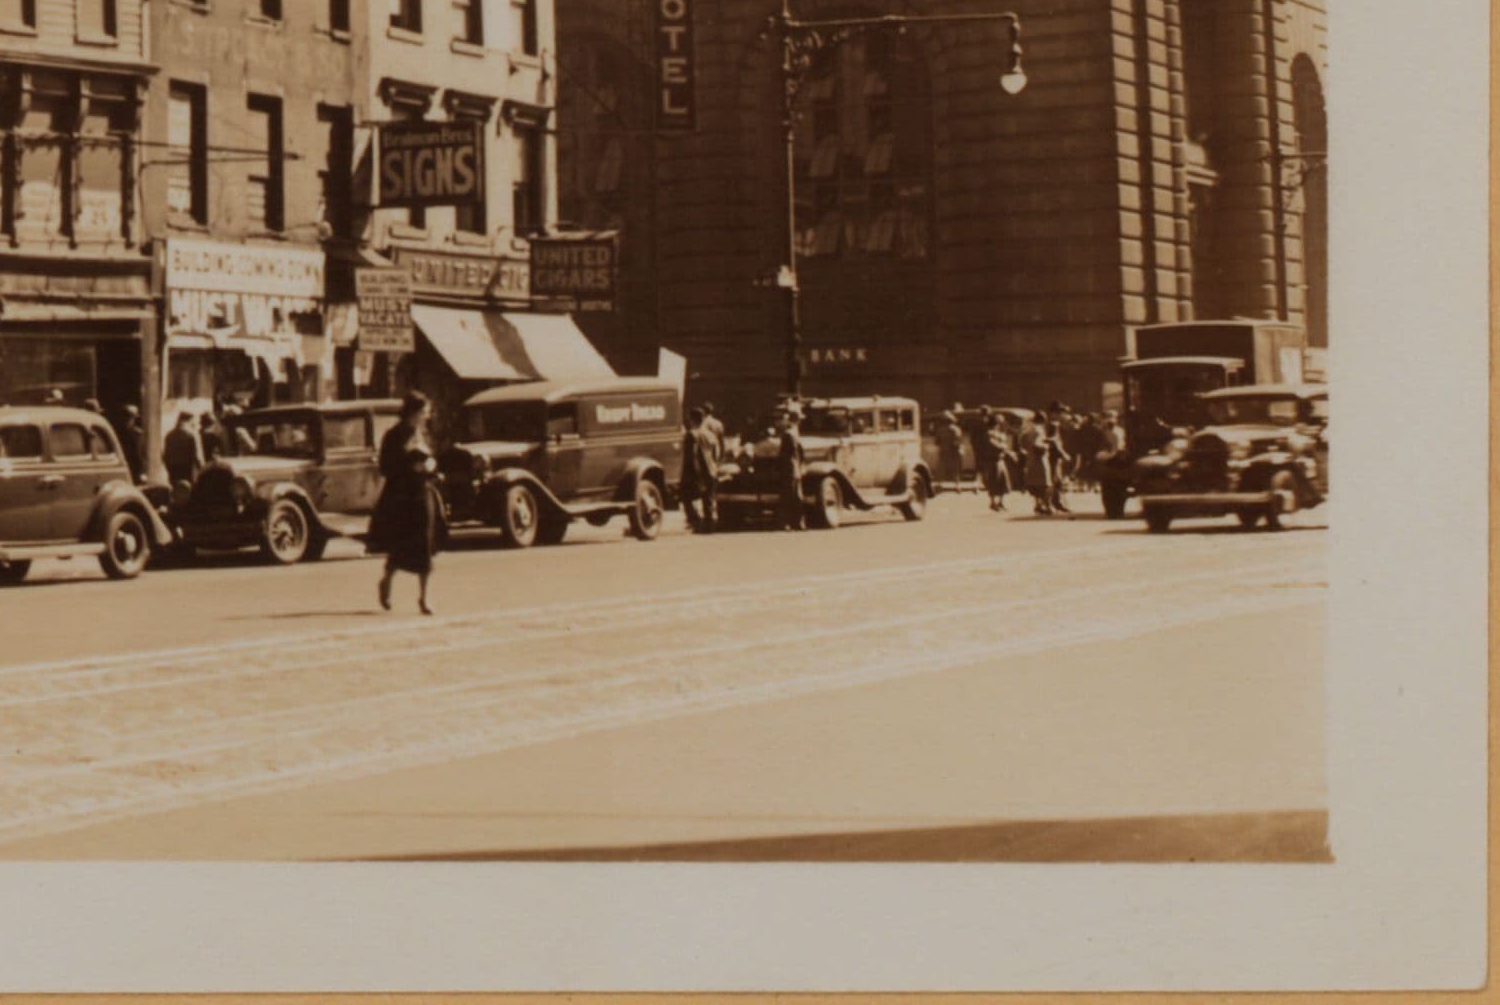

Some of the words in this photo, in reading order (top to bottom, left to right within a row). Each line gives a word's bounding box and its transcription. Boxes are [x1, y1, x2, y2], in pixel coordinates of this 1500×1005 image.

[383, 145, 475, 199] SIGNS
[174, 249, 233, 276] BUILDING
[533, 246, 611, 266] UNITED
[411, 259, 491, 289] UNITED
[533, 268, 610, 290] CIGARS
[360, 298, 409, 311] MUST
[359, 312, 412, 325] VACATE
[810, 347, 868, 363] BANK
